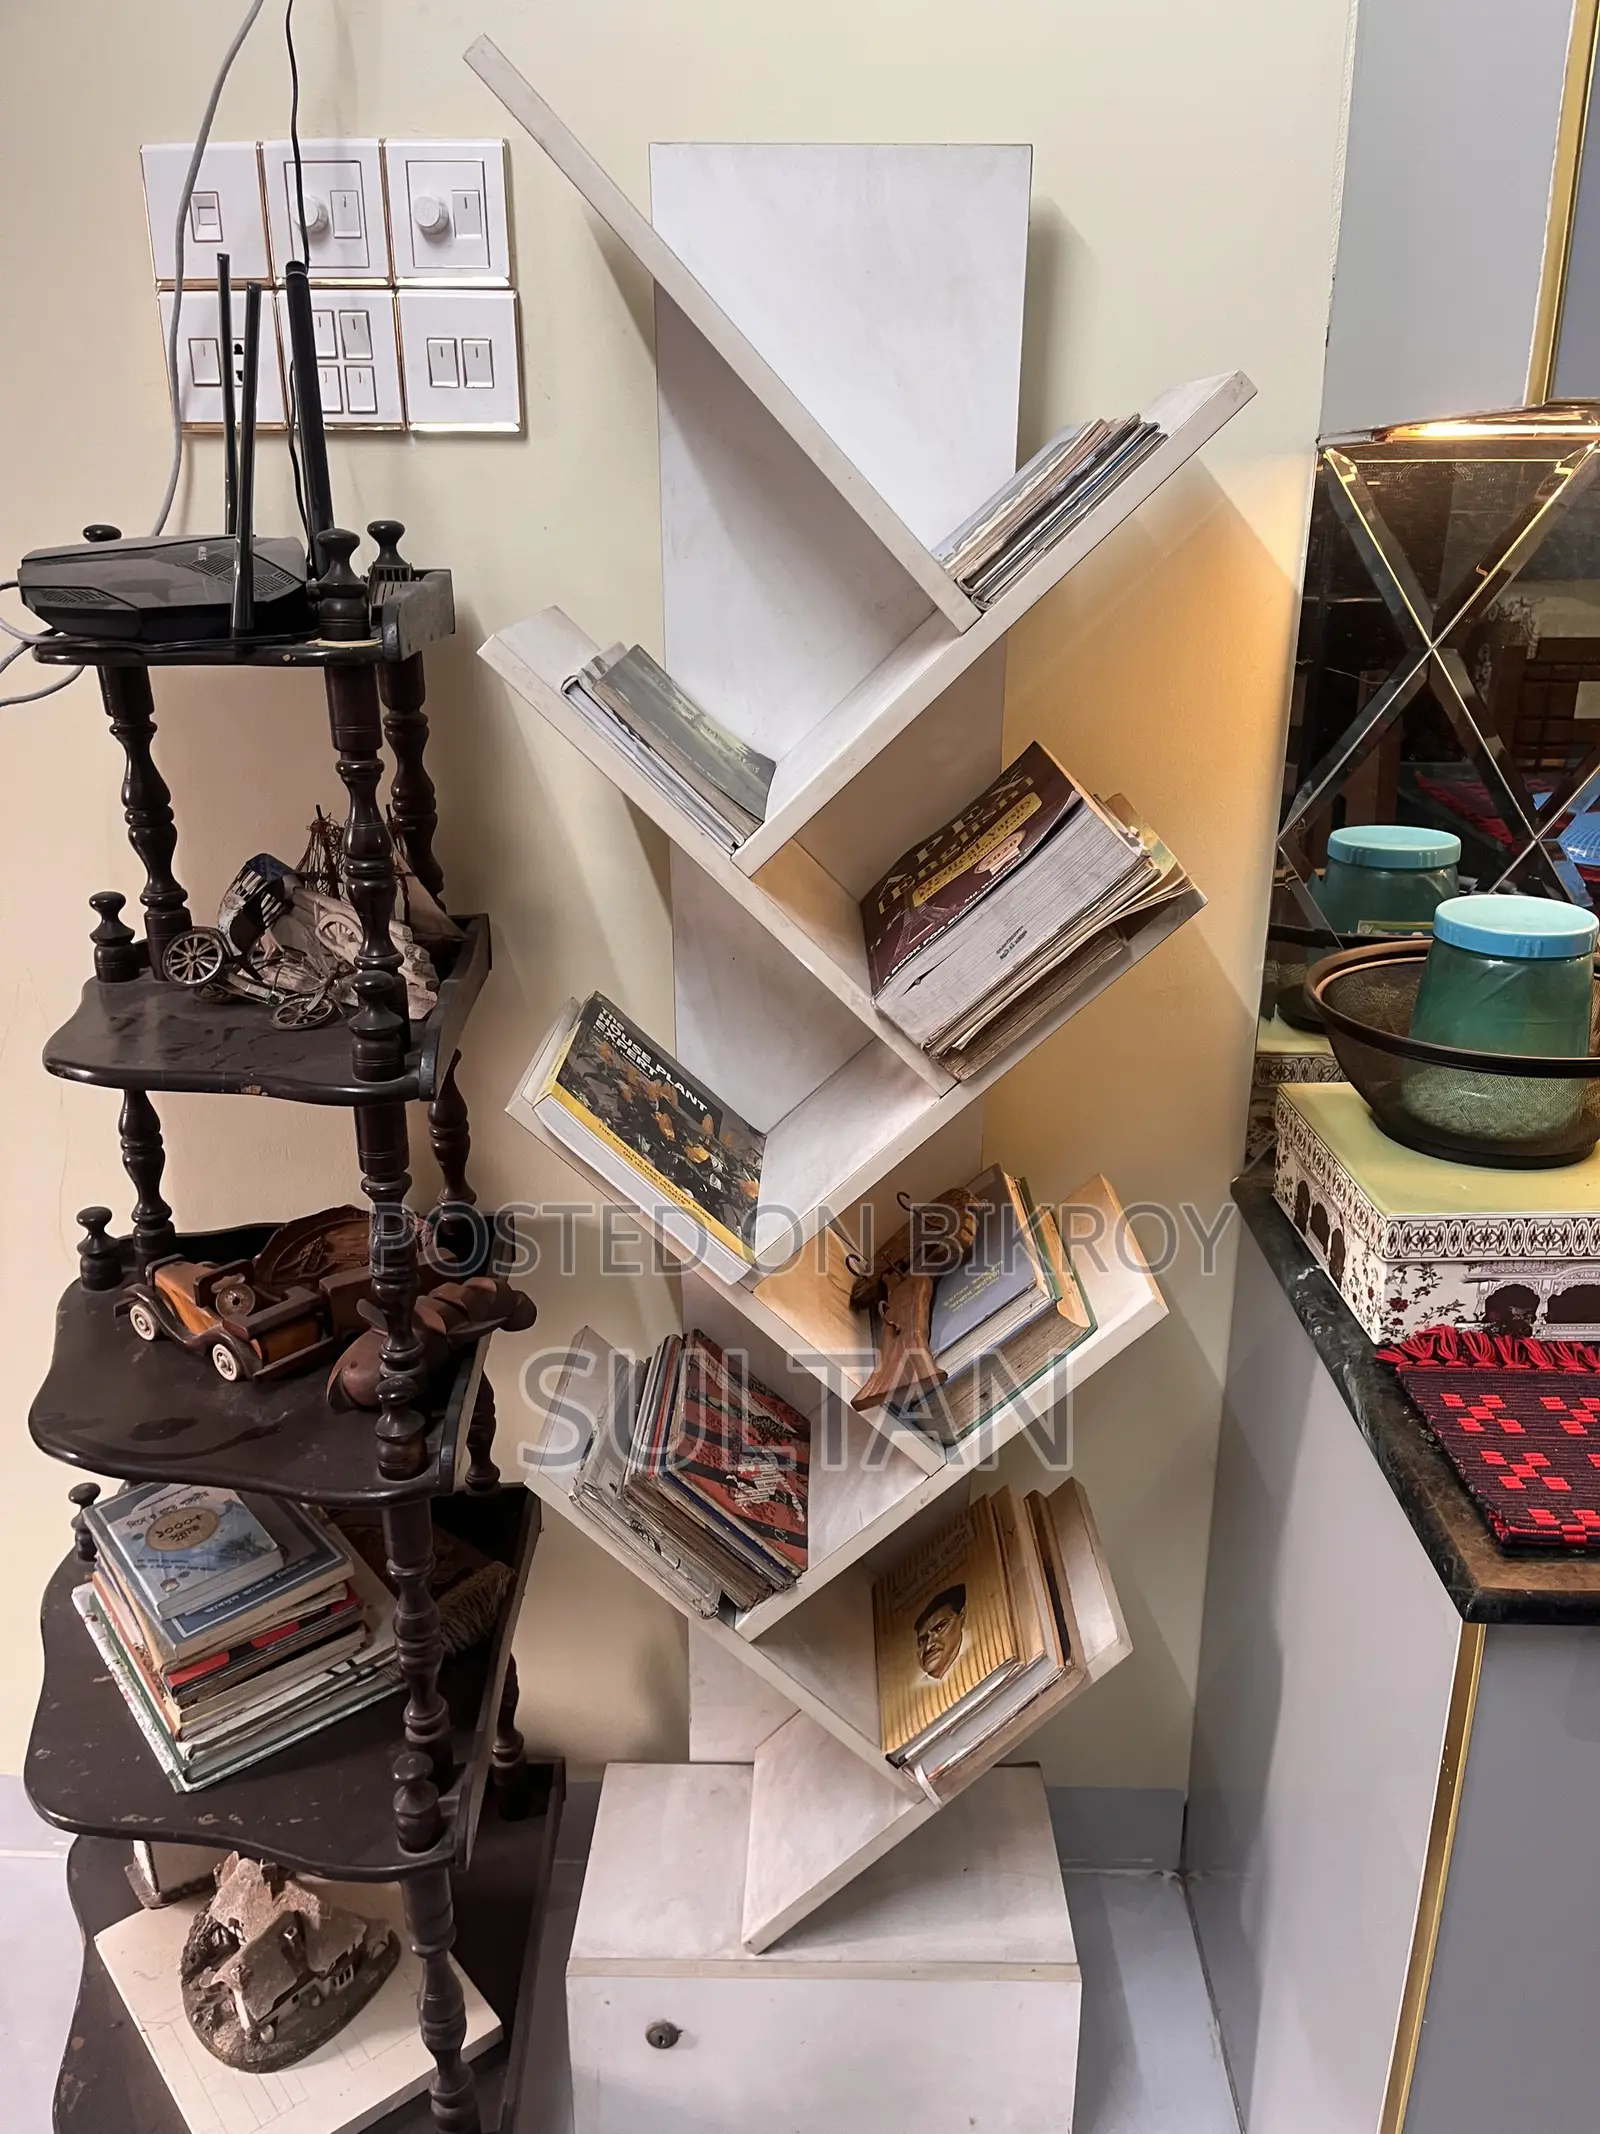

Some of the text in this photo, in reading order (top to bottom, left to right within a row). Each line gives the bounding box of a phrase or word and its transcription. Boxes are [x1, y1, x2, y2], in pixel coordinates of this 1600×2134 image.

[984, 838, 1018, 867] 2020
[891, 945, 921, 974] BOOK
[923, 925, 946, 945] FOR
[601, 1006, 625, 1031] The
[595, 1019, 658, 1076] EXPERT
[598, 1012, 708, 1112] HOUSE PLANT
[598, 1124, 611, 1136] THE
